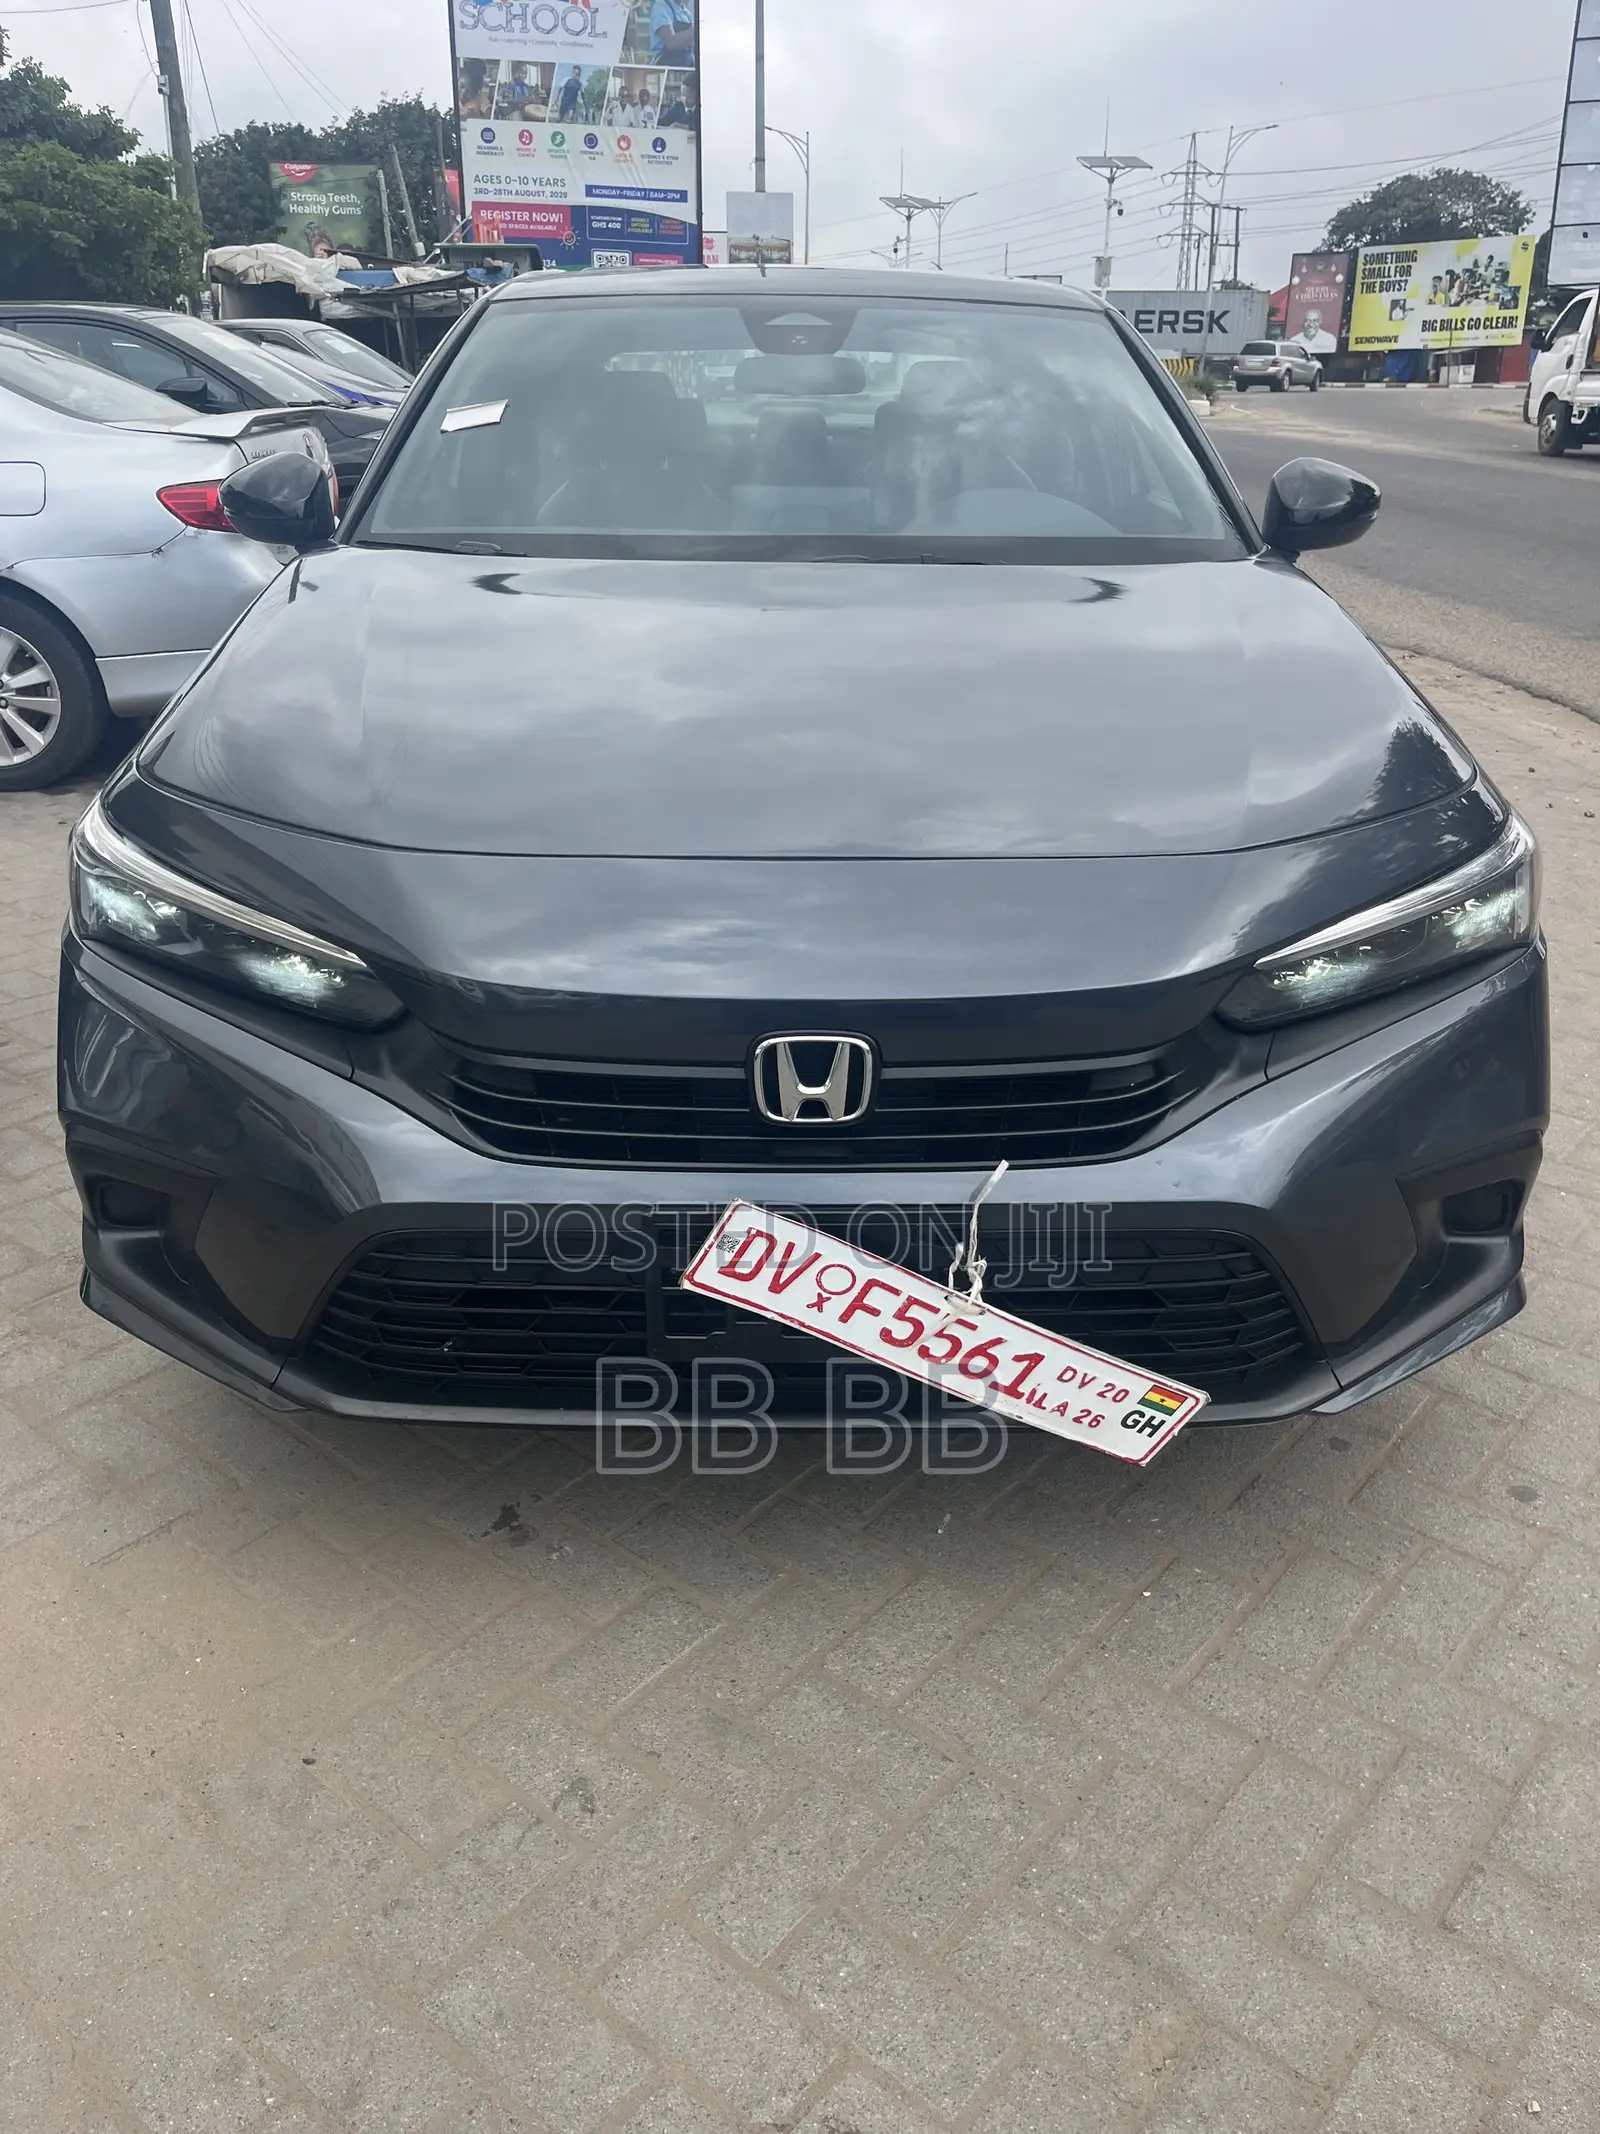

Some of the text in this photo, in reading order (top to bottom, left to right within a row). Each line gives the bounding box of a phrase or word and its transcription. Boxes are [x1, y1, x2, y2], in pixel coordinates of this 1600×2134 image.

[459, 0, 608, 39] SCHOOL
[474, 174, 566, 187] AGES 0-10 YEARS
[290, 191, 360, 205] Strong Teeth,
[514, 190, 548, 199] AUGUST,
[289, 204, 330, 217] Healthy
[480, 210, 564, 223] REGISTER NOW!
[1362, 250, 1418, 266] SOMETHING
[1361, 264, 1412, 280] SMALL FOR
[1360, 279, 1409, 294] THE BOYS?
[1295, 292, 1338, 300] CHRISTMAS
[1118, 309, 1230, 334] ERSK
[1421, 315, 1518, 332] BIG BILLS GO CLEAR!
[1354, 335, 1399, 345] SENDWAVE
[1056, 1365, 1130, 1403] DV 20
[1071, 1408, 1105, 1428] 26
[1120, 1409, 1166, 1438] GH
